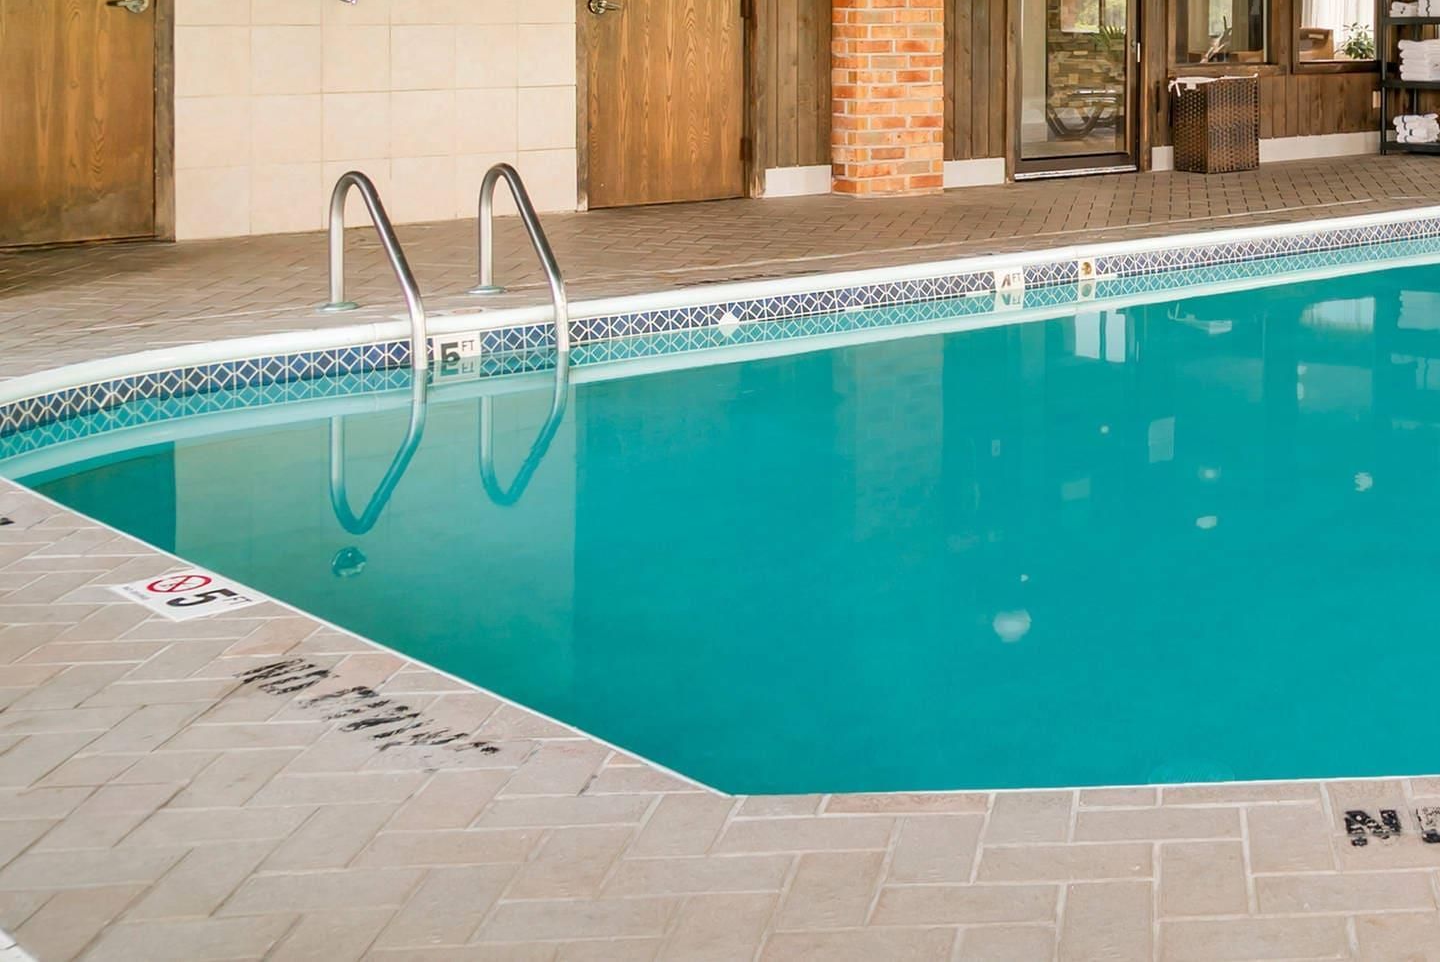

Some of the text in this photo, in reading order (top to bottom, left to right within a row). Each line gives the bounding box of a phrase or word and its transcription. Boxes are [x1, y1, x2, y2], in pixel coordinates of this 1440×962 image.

[441, 339, 474, 364] 5 FT
[166, 588, 238, 608] 5
